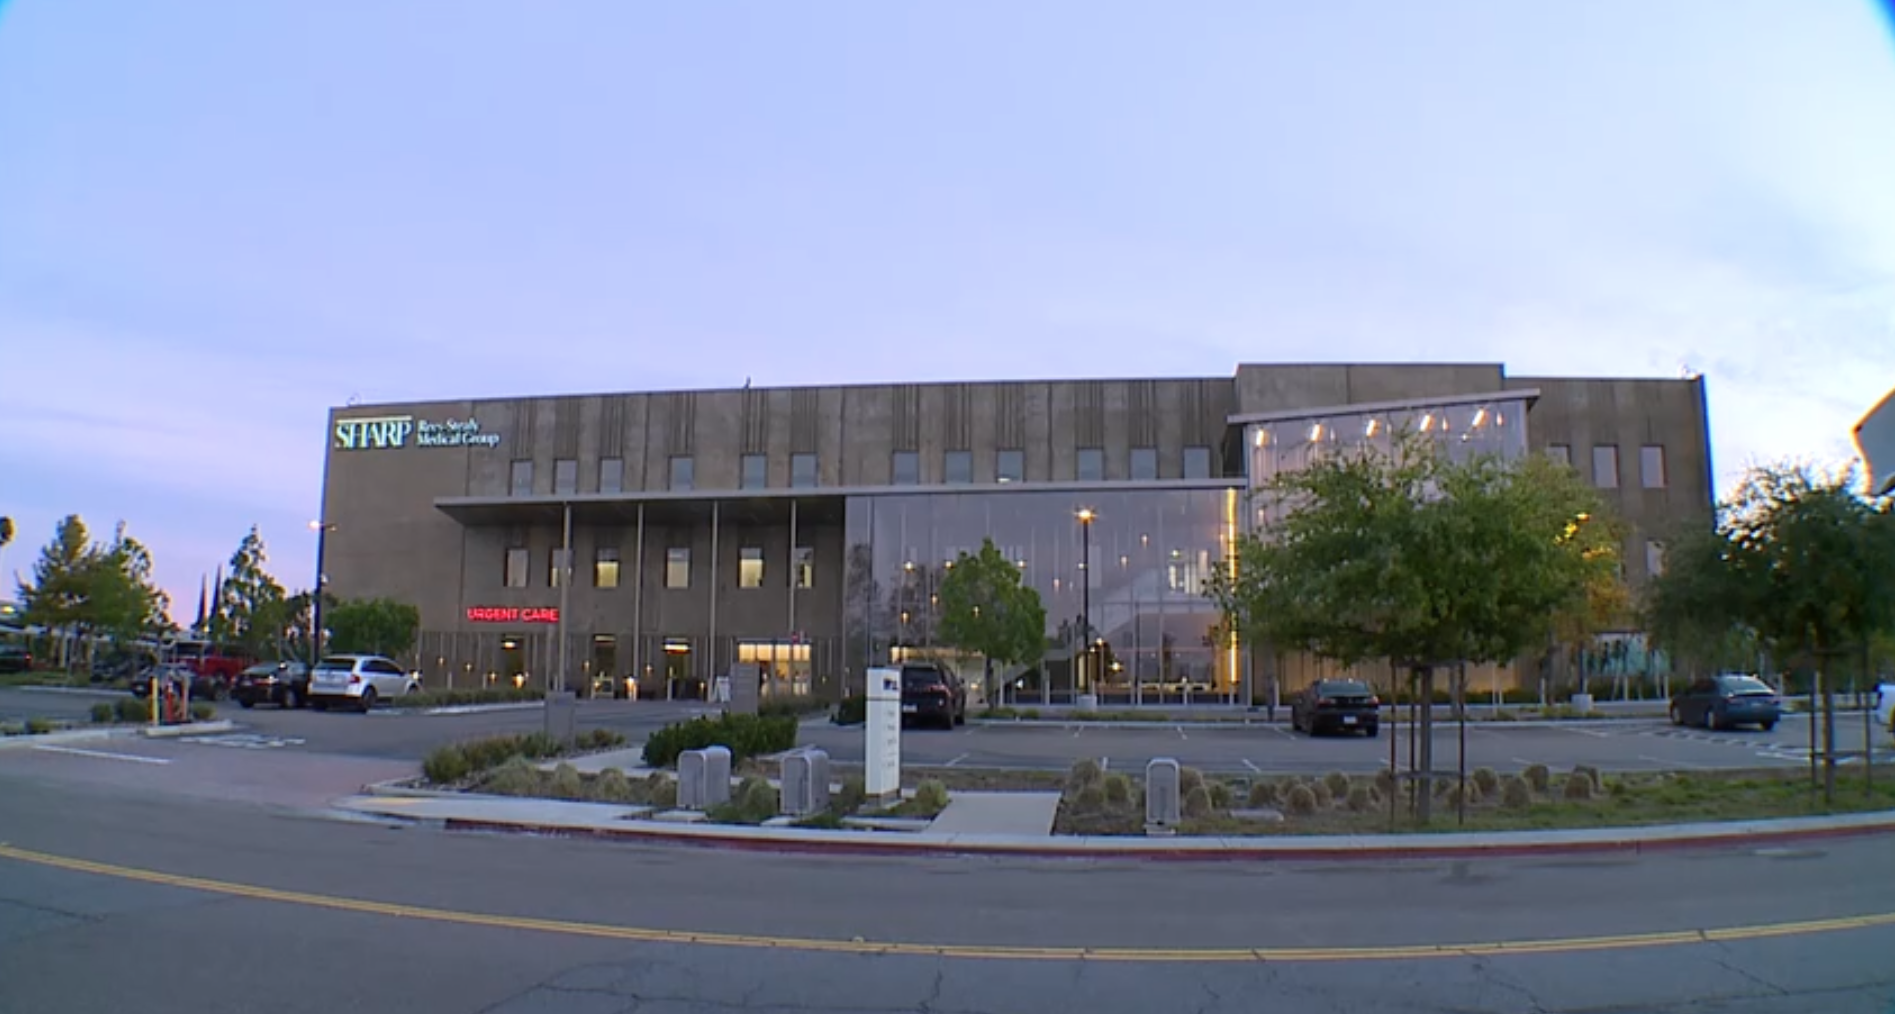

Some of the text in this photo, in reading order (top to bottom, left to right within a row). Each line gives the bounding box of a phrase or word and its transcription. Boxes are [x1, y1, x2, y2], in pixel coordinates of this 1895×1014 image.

[335, 417, 412, 448] SHARP
[417, 431, 500, 447] Medical Group
[466, 607, 560, 622] URGENT CARE
